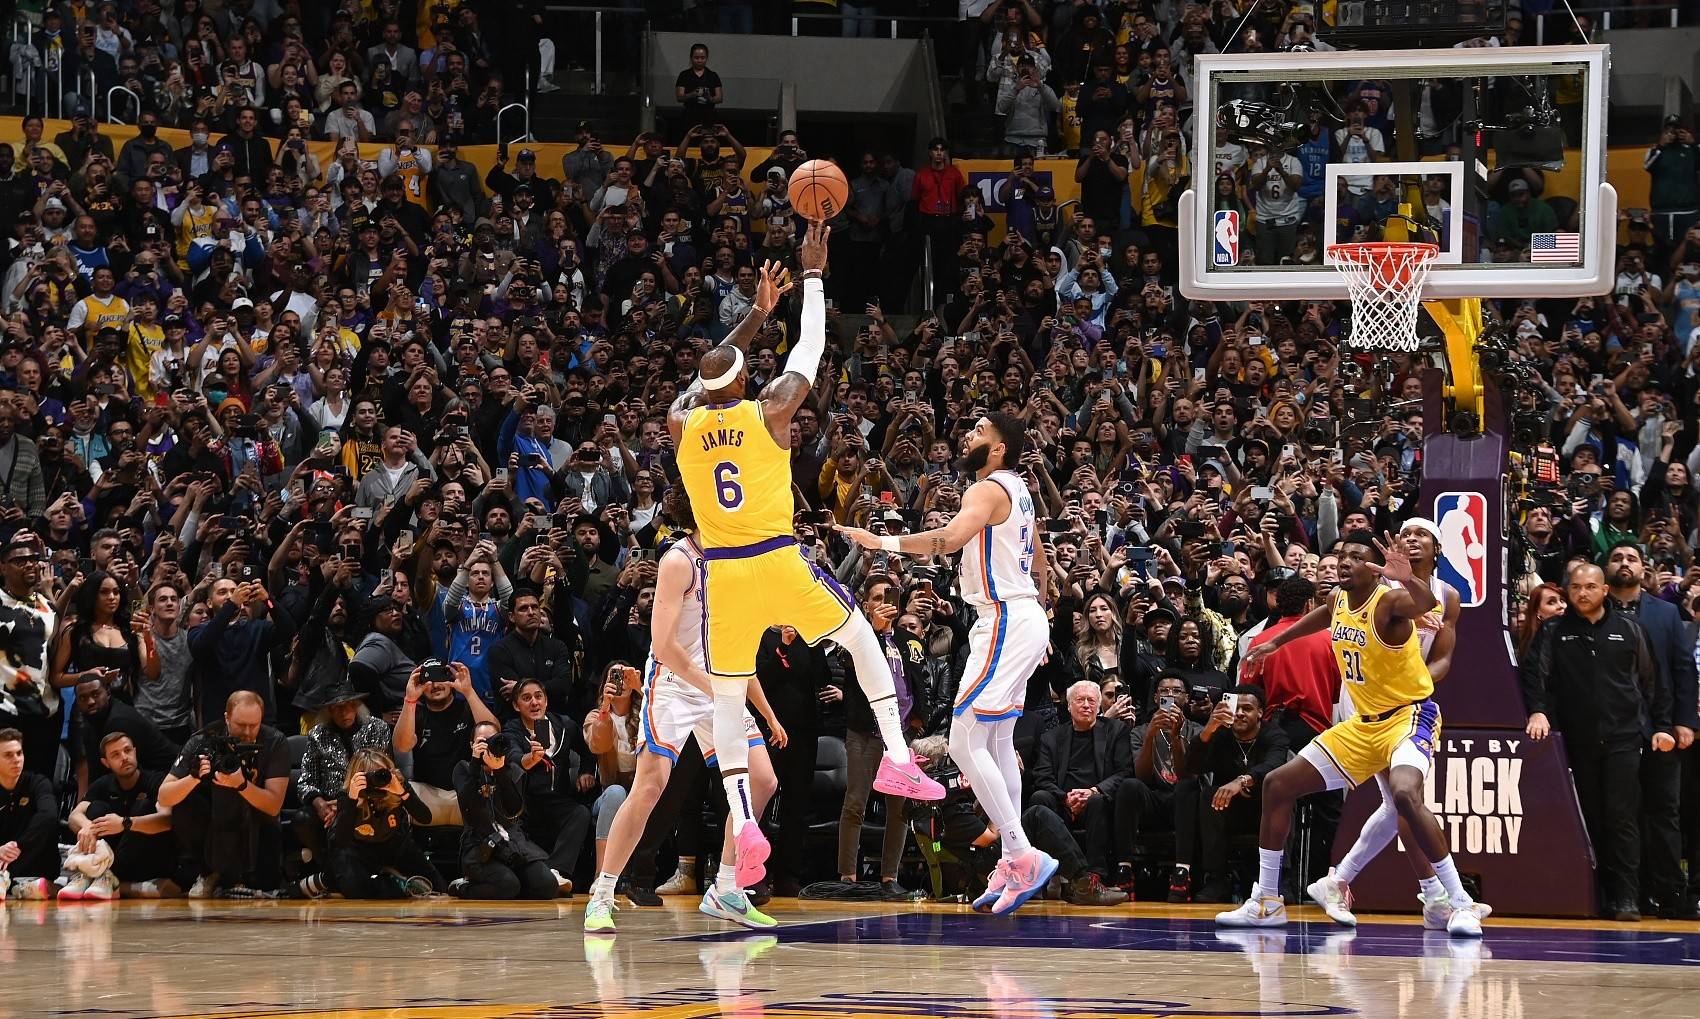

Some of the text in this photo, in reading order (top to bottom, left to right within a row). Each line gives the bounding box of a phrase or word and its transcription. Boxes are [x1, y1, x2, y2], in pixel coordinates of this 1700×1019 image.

[1271, 185, 1280, 200] 6
[1216, 254, 1230, 263] NBA
[701, 429, 744, 451] JAMES
[713, 461, 745, 513] 6
[1332, 621, 1368, 647] LAKERS
[470, 635, 481, 656] 2
[1342, 649, 1365, 682] 31
[1488, 739, 1521, 754] BY
[1423, 756, 1524, 816] LACK
